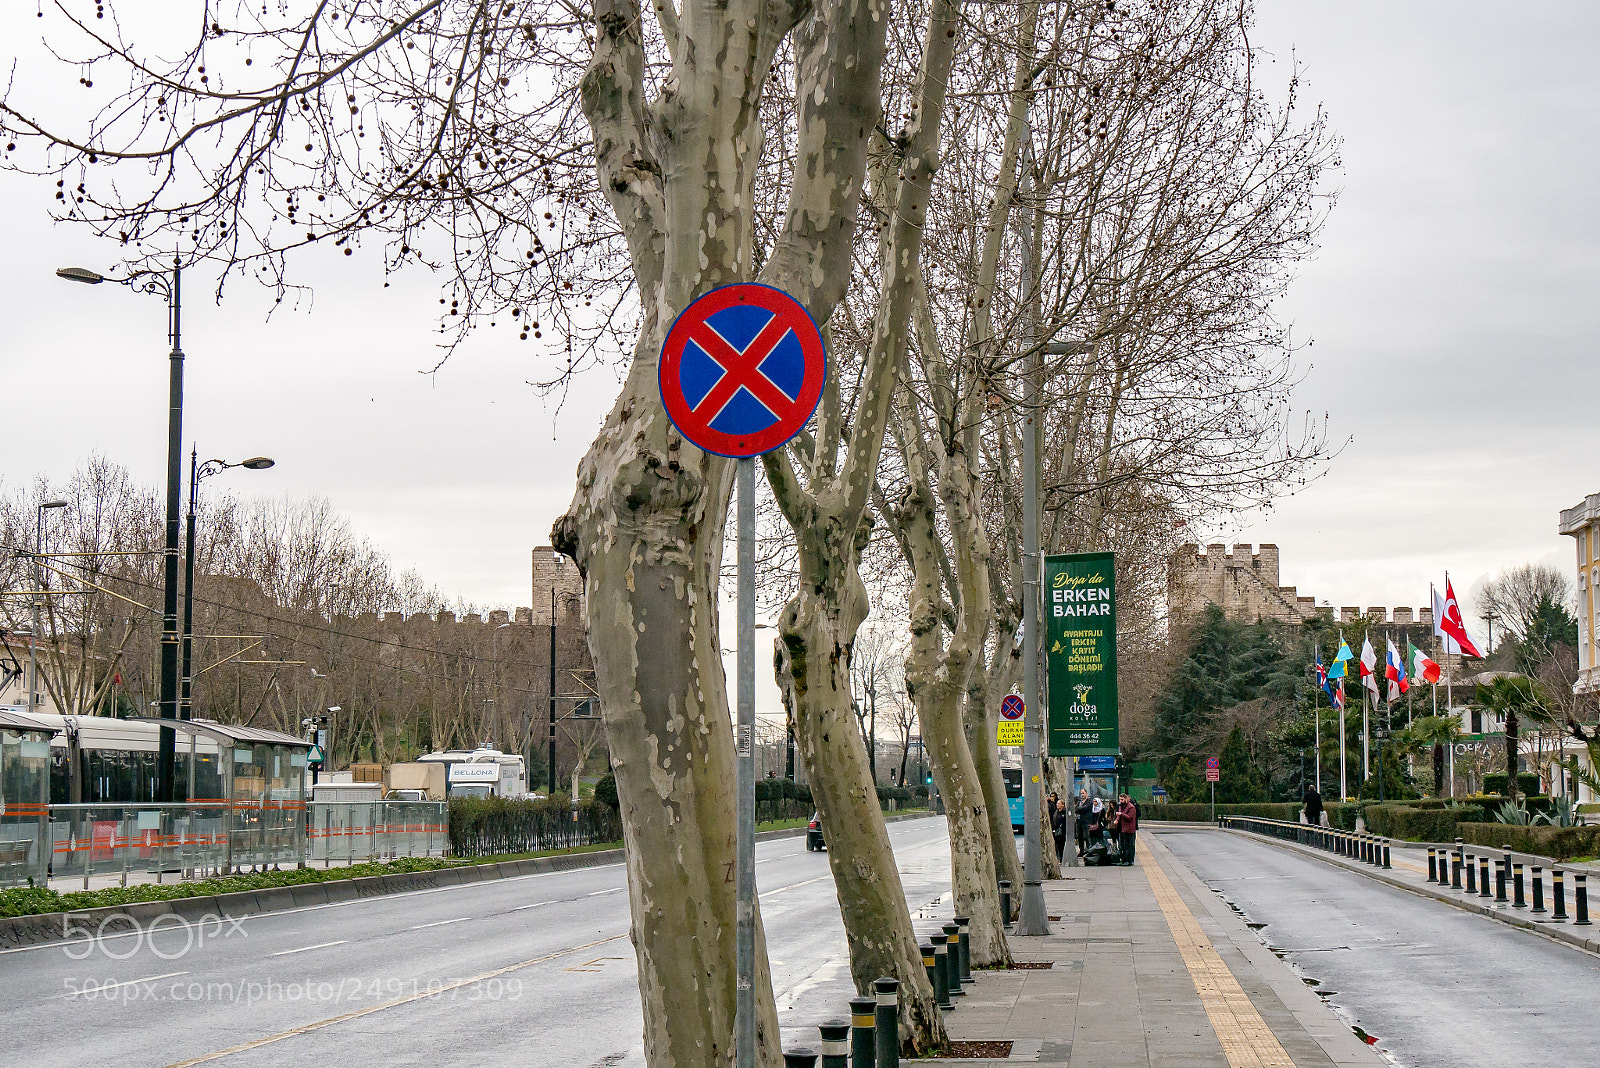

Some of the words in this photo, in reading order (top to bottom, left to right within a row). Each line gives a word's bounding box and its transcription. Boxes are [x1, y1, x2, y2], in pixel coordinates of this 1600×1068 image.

[1052, 588, 1110, 603] ERKEN
[1053, 603, 1111, 617] BAHAR
[1063, 629, 1103, 638] AVANTAJLI
[1072, 647, 1096, 655] KAYIT
[1069, 701, 1097, 717] doğa
